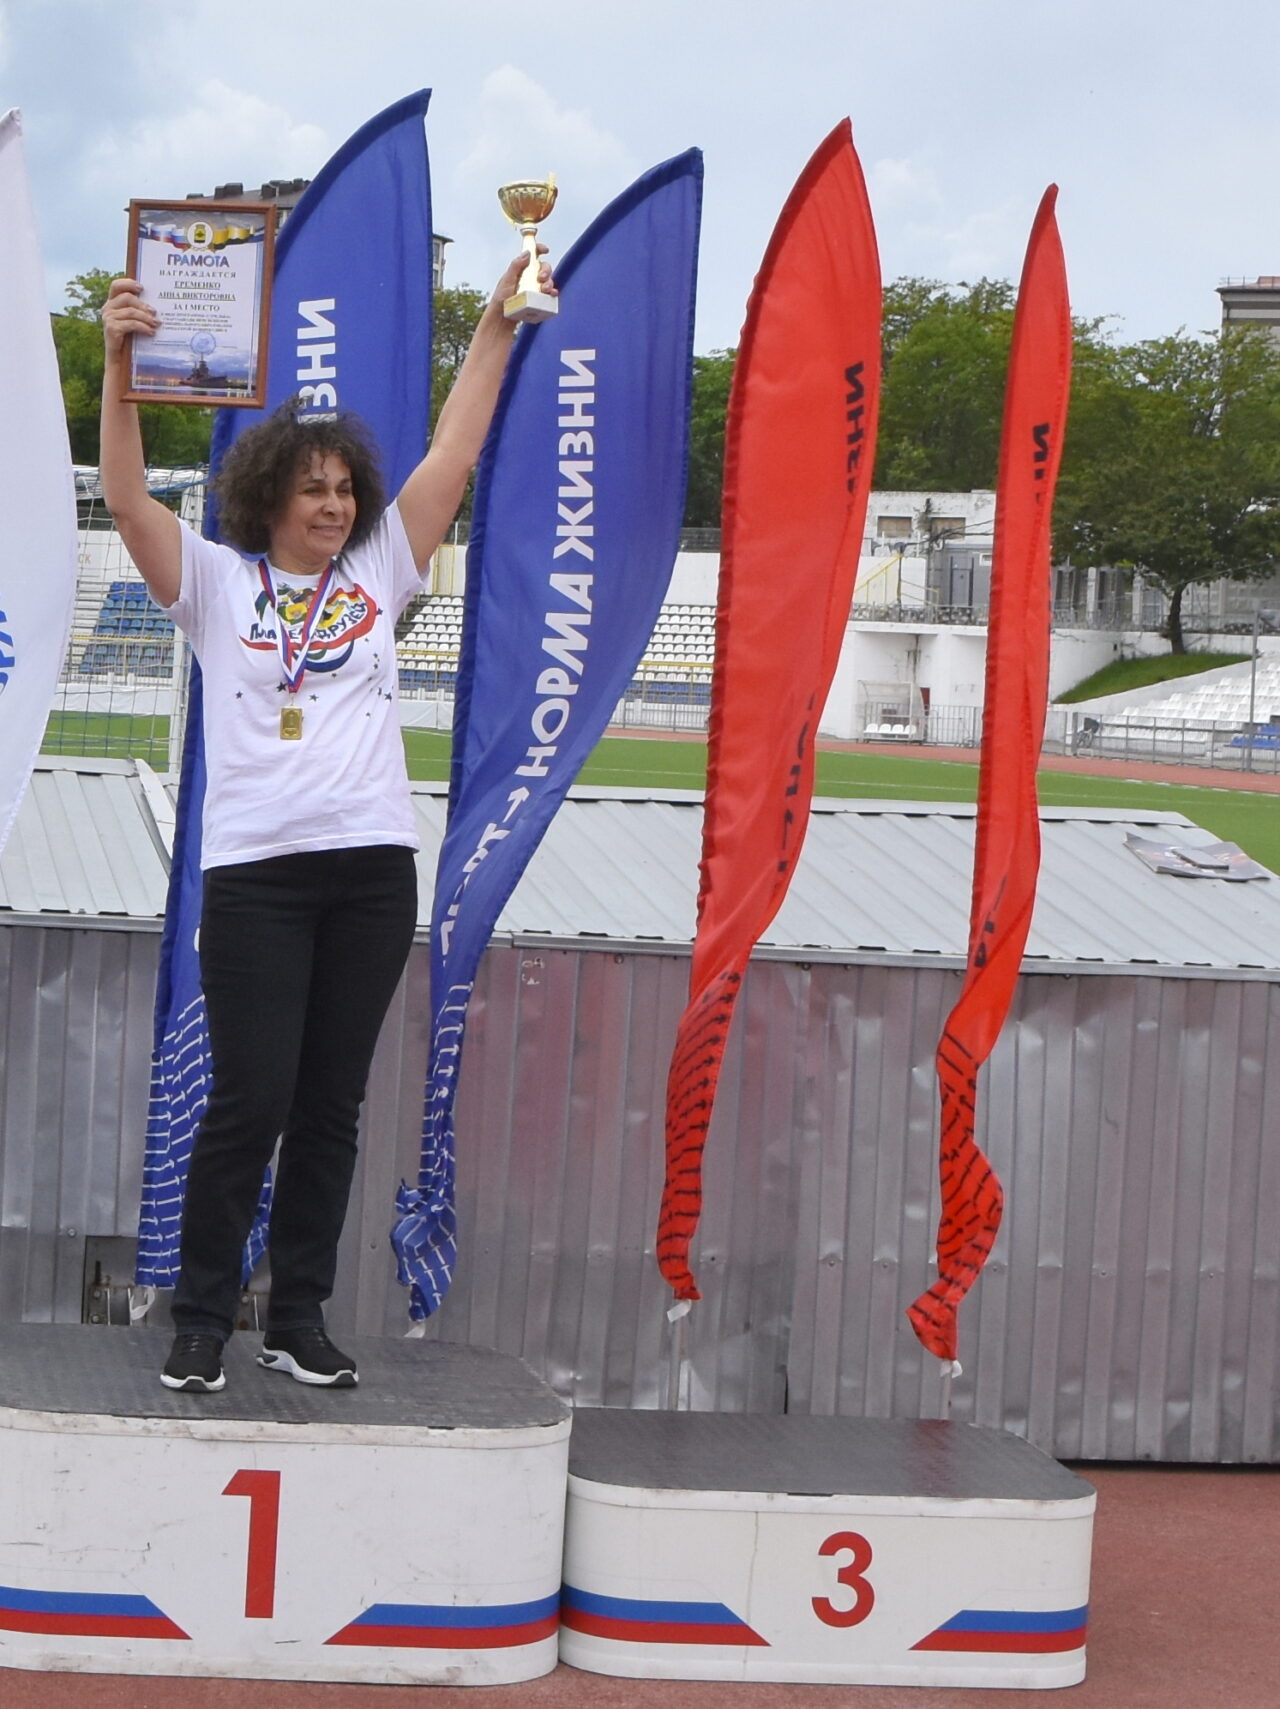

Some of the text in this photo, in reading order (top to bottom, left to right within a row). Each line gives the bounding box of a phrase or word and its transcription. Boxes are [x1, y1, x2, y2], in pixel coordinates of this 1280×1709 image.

[159, 270, 236, 278] НАГРАЖДАЕТСЯ
[167, 253, 230, 268] ГРАМОТА
[182, 292, 236, 301] ВИКТОРОВНА
[190, 304, 220, 312] МЕСТО
[553, 348, 596, 562] ЖИЗНИ
[514, 573, 594, 777] НОРМА
[222, 1470, 281, 1619] 1
[812, 1531, 874, 1628] 3
